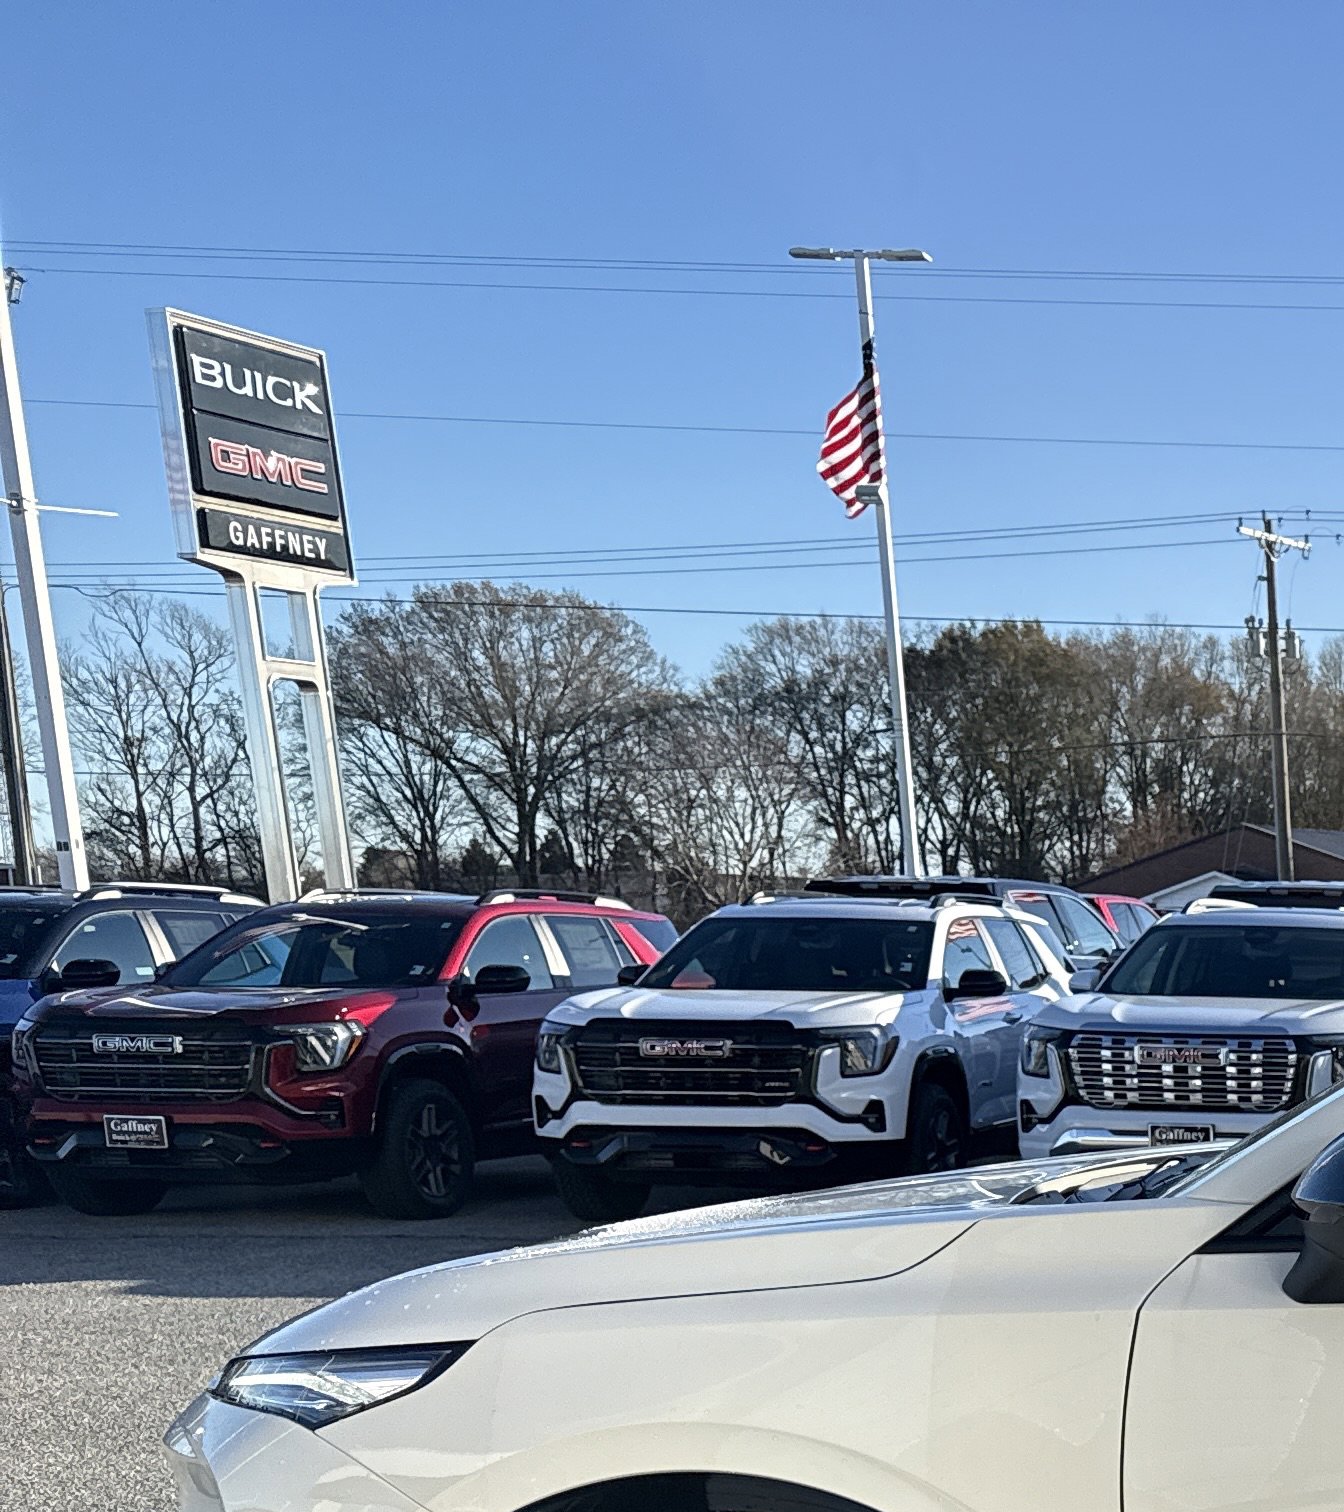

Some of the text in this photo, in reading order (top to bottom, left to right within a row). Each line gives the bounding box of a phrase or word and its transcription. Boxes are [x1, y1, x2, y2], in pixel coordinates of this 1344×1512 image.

[190, 353, 324, 415] BUICK
[208, 436, 329, 494] GMC
[228, 520, 328, 560] GAFFNEY
[95, 1035, 173, 1053] GMC
[642, 1039, 724, 1056] GMC
[110, 1119, 158, 1135] Gaffney
[1153, 1127, 1206, 1141] Gaffney
